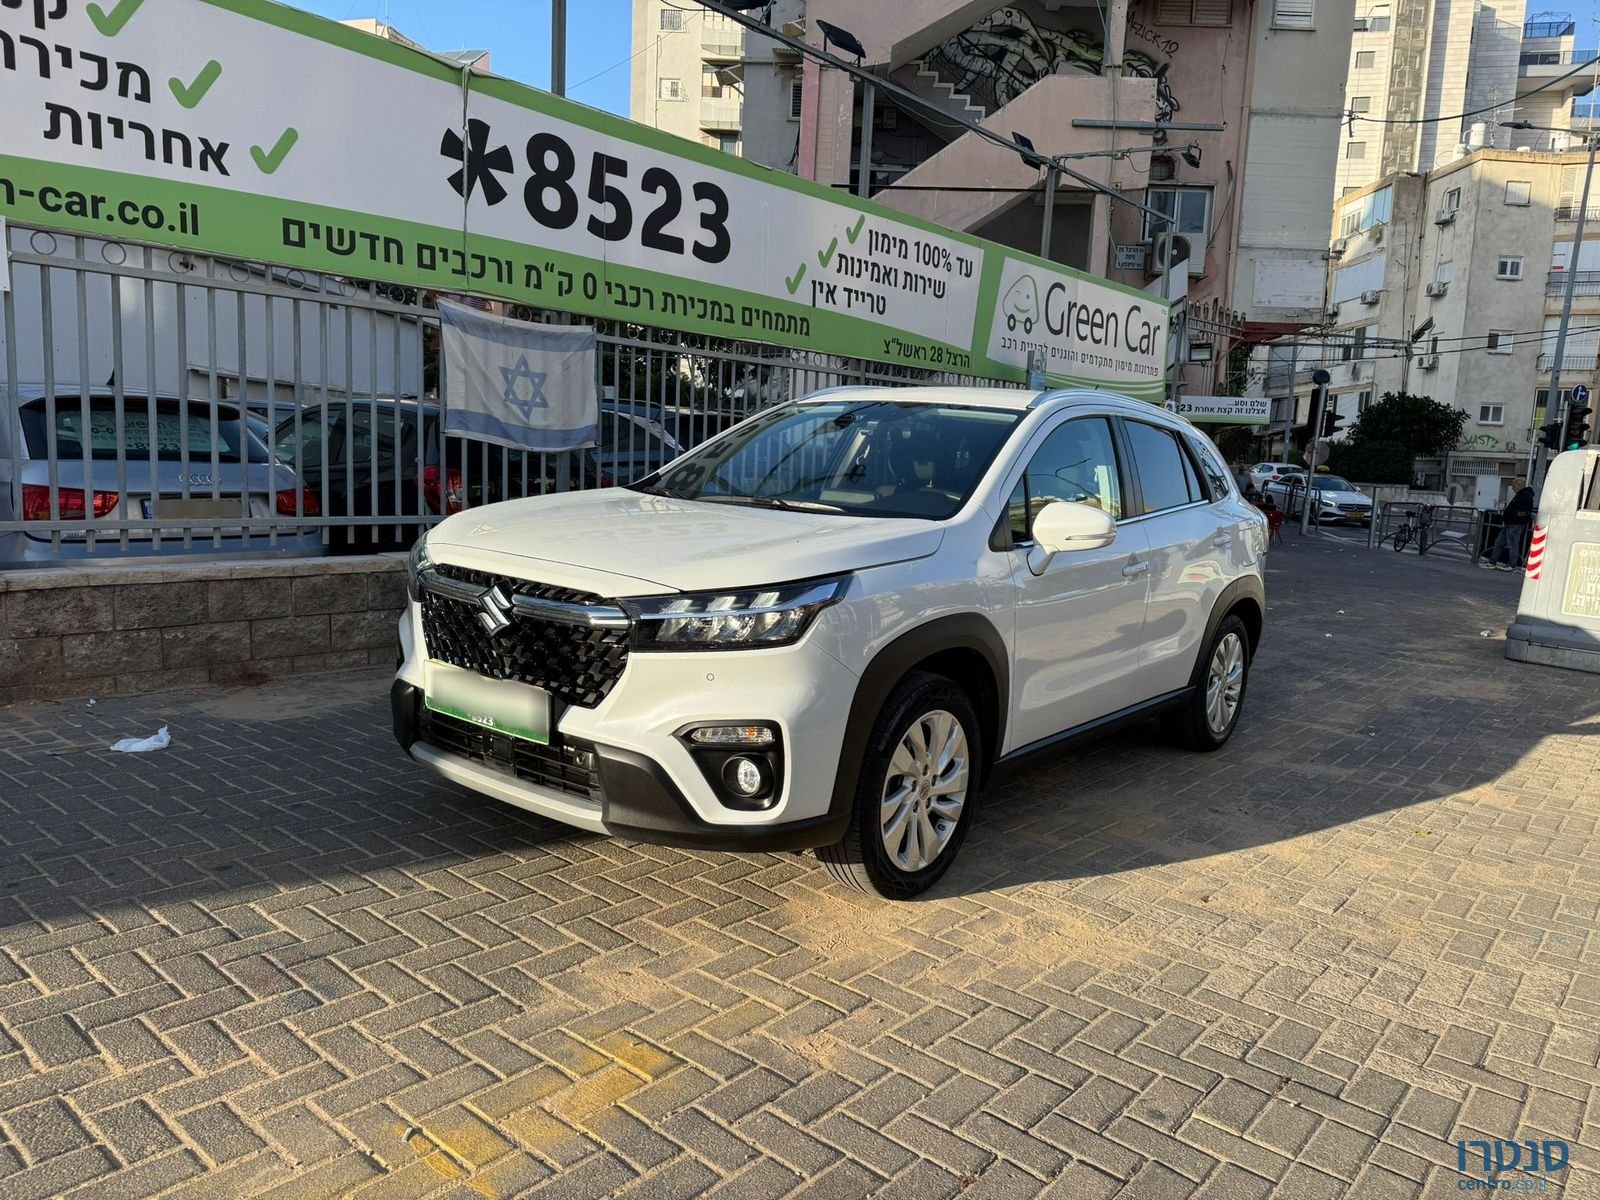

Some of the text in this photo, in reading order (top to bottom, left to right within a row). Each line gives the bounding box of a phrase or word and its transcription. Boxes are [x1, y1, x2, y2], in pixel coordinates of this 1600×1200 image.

[43, 102, 230, 176] אחריות
[281, 217, 404, 266] חדשים
[868, 228, 973, 279] עד 100% מימון
[416, 243, 513, 285] ורכבים
[836, 252, 946, 299] שירות ואמינות
[605, 280, 655, 311] רכבי
[661, 291, 735, 325] במכירת
[811, 278, 887, 315] טרייד אין
[741, 306, 810, 337] מתמחים
[1044, 282, 1161, 356] Green Car
[930, 346, 943, 363] 28
[946, 349, 970, 369] הרצל
[1001, 337, 1018, 350] רכב
[1051, 347, 1078, 362] והוגנים
[1080, 353, 1113, 369] מתקדמים
[1115, 360, 1133, 372] מימון
[1133, 362, 1159, 376] פתרונות
